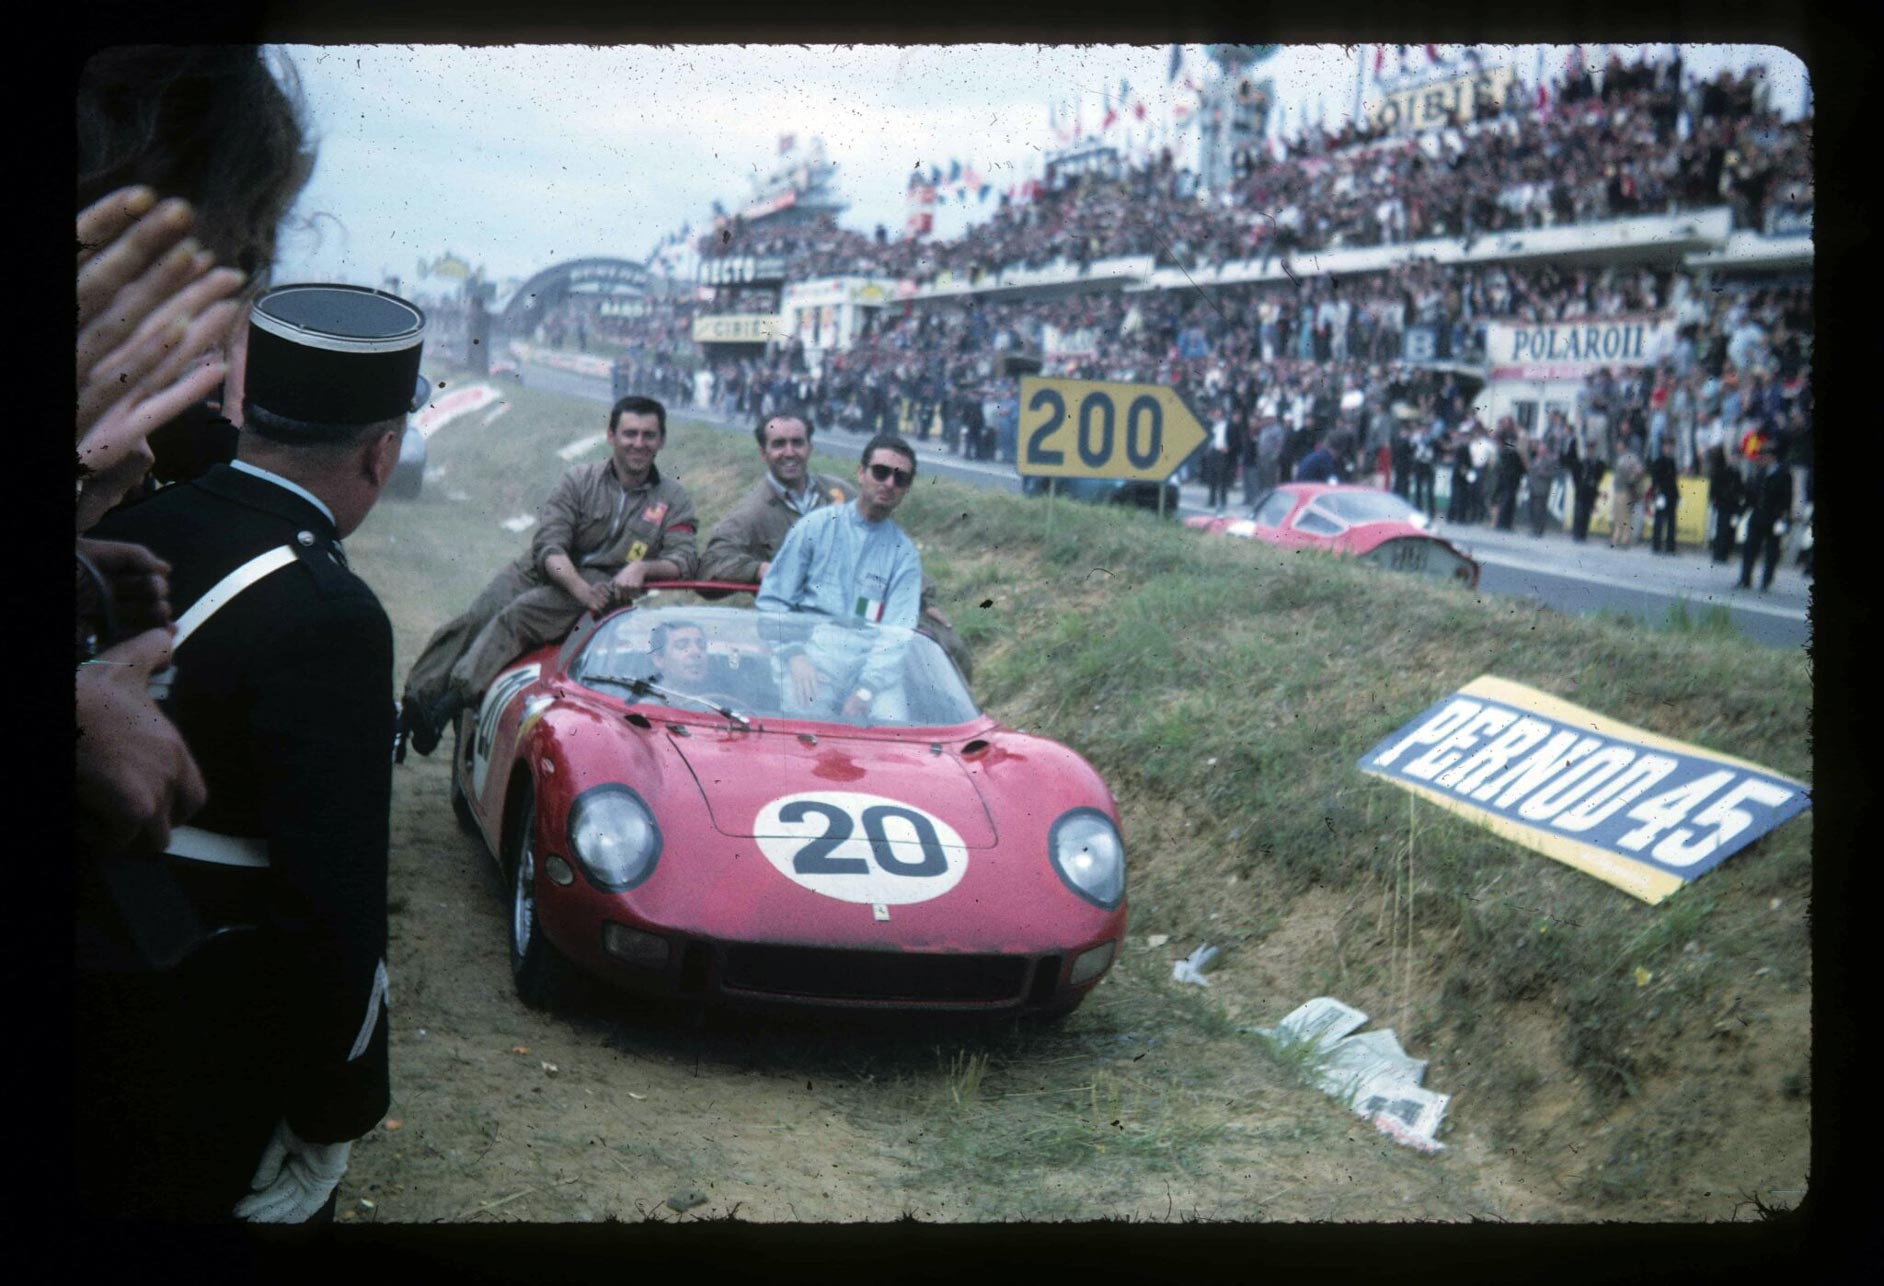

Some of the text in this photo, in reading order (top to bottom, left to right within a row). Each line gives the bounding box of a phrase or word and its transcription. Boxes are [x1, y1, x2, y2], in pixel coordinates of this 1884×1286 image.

[1027, 389, 1163, 469] 200
[1374, 701, 1794, 867] PERNOD 45
[779, 800, 950, 879] 20
